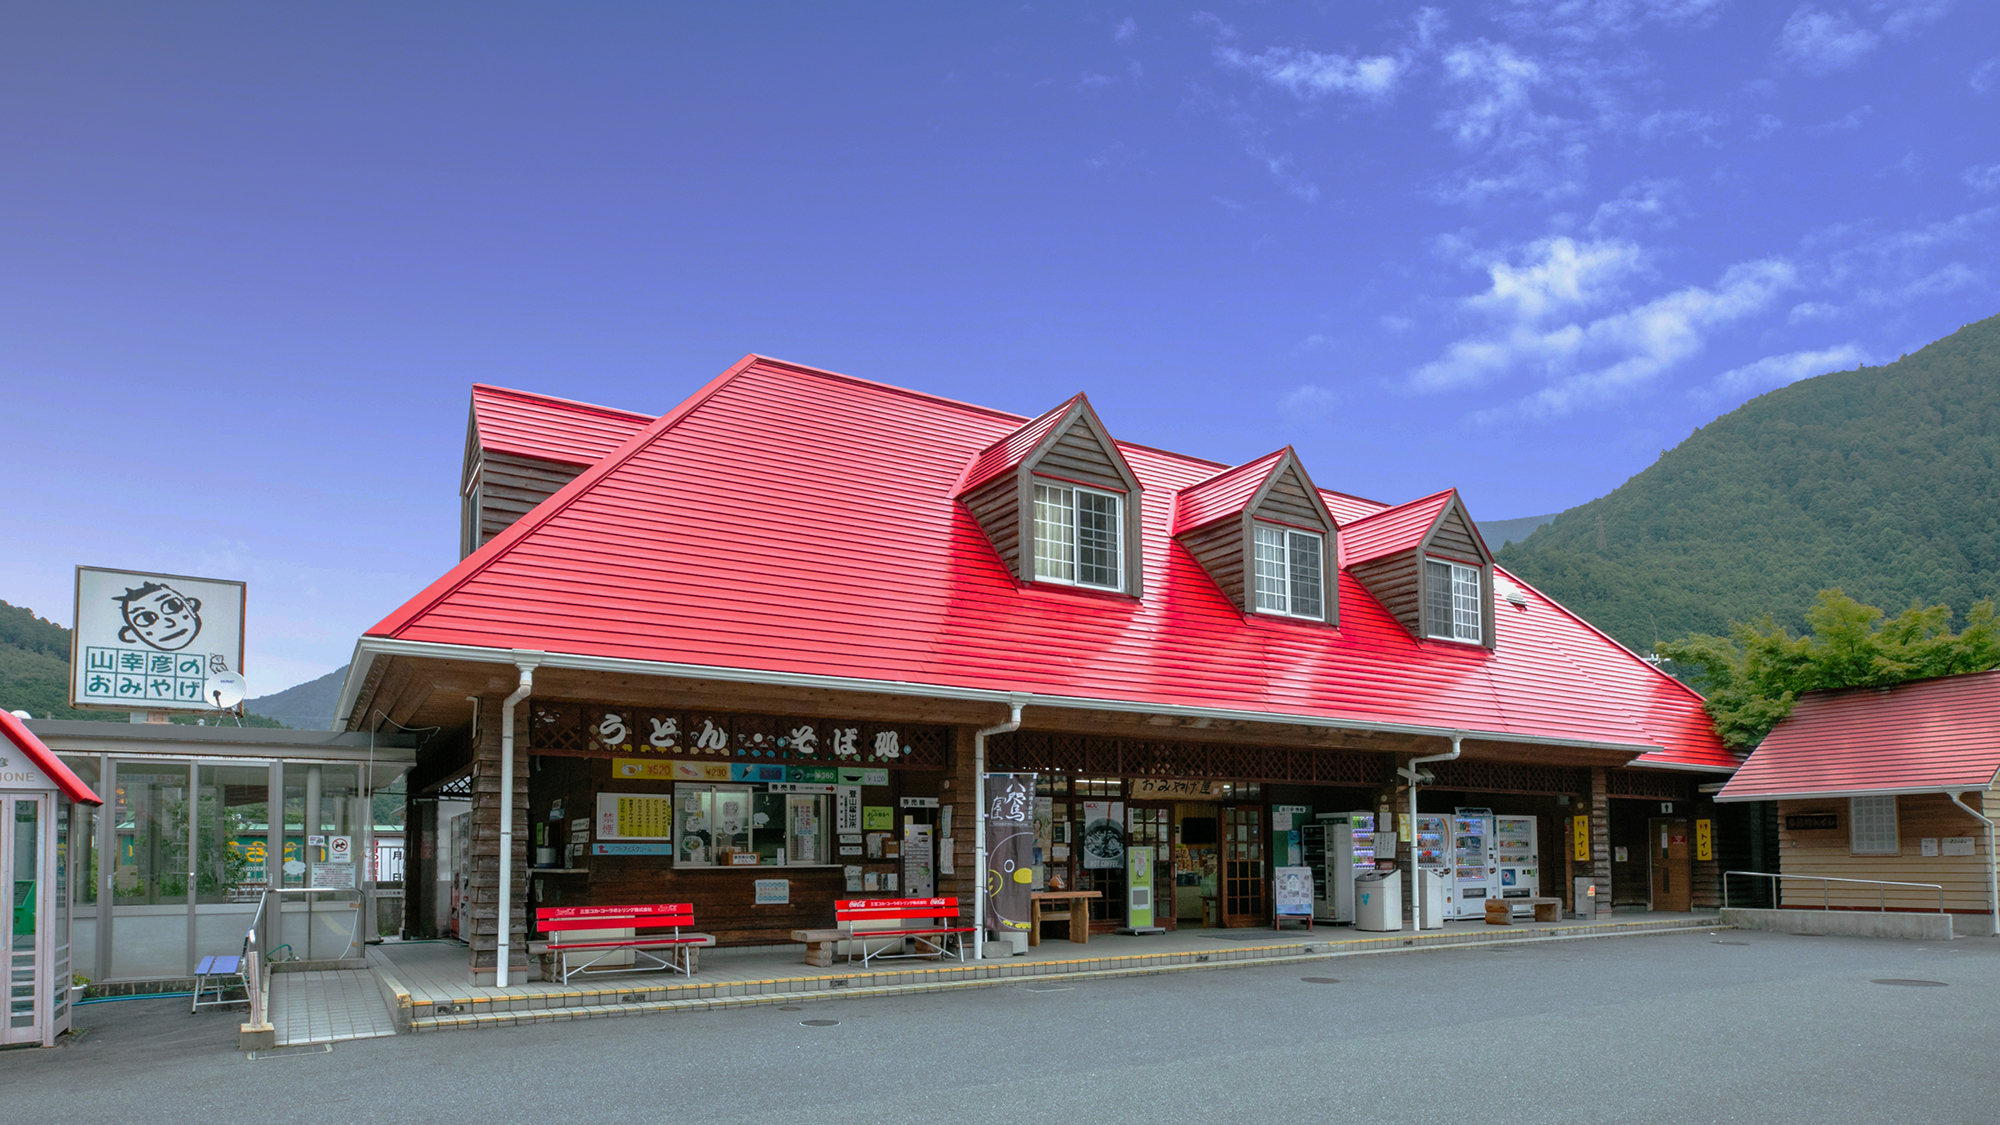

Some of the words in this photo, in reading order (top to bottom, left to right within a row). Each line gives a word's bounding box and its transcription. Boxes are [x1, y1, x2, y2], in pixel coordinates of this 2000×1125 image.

[90, 650, 200, 675] 山幸彦の
[88, 674, 200, 698] おみやげ
[0, 771, 35, 782] ONE
[771, 783, 797, 792] 券売機
[1142, 778, 1212, 795] おみやげ屋
[602, 812, 614, 836] 禁煙
[1578, 831, 1587, 857] トイレ
[1700, 833, 1709, 857] トイレ
